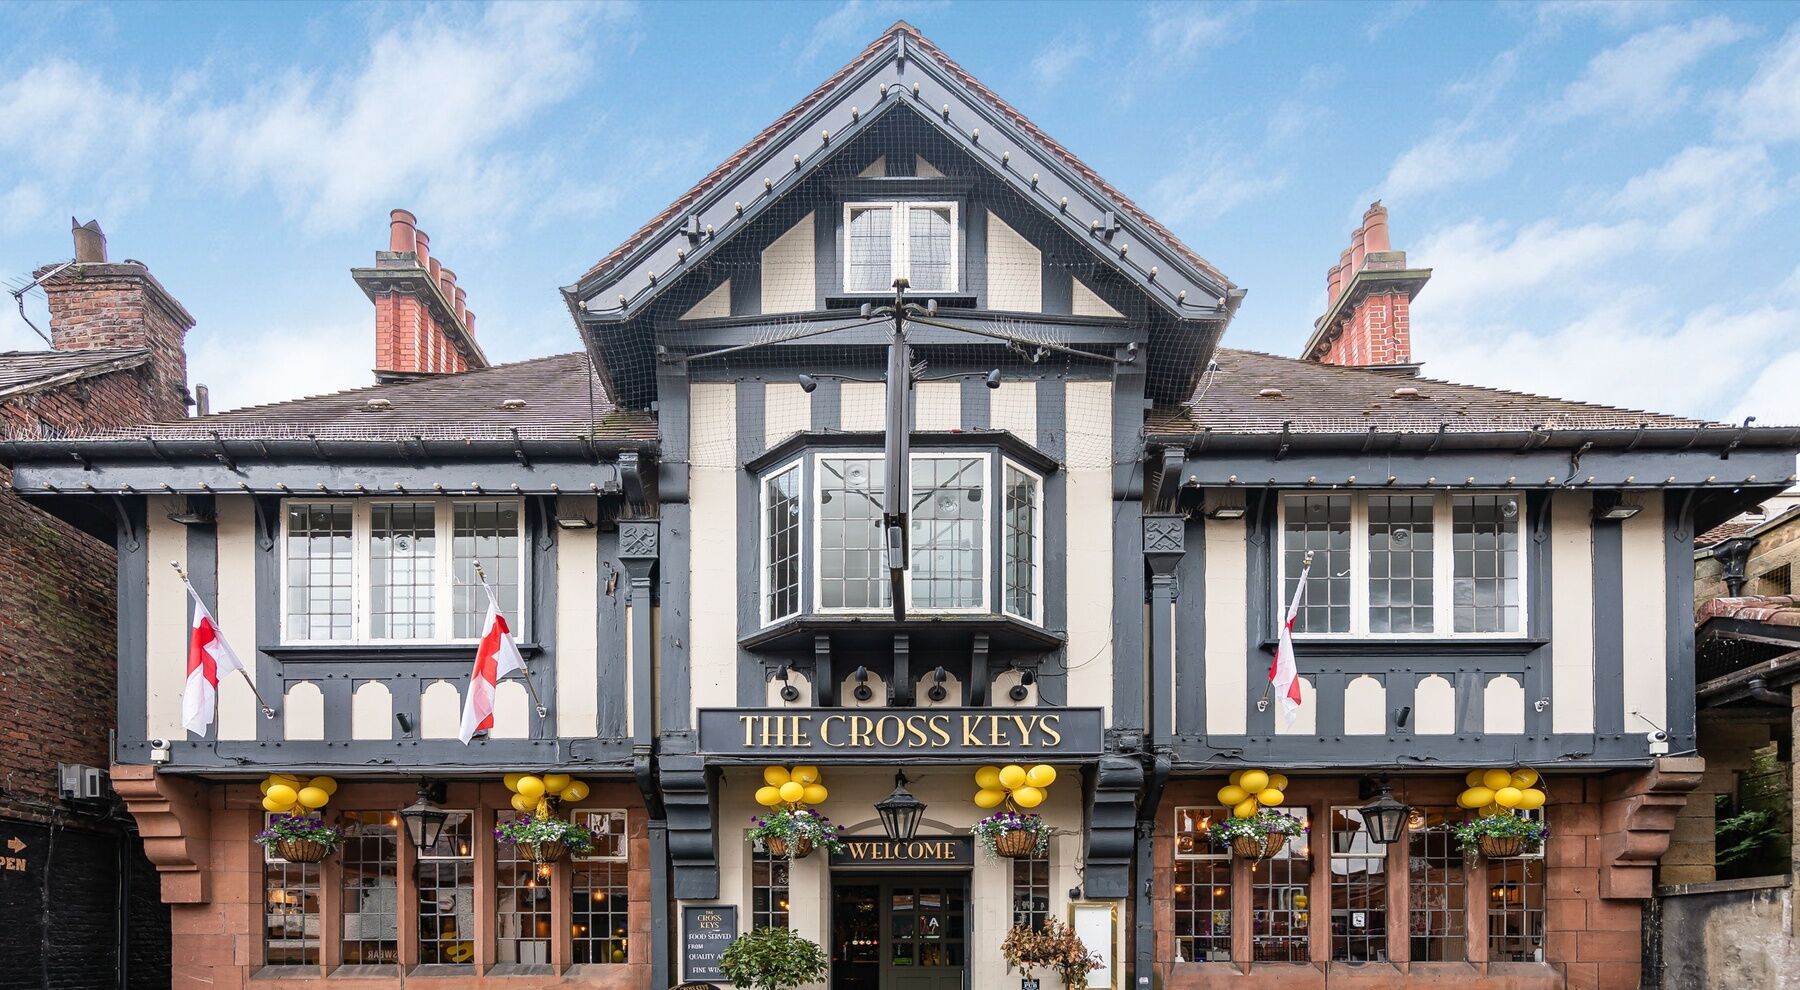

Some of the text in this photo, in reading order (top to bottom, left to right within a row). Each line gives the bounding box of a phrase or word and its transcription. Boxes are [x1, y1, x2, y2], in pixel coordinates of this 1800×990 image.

[739, 714, 1061, 748] THE CROSS KEYS
[847, 841, 956, 860] WELCOME
[0, 856, 27, 872] PEN
[700, 921, 720, 929] KEYS
[688, 953, 715, 961] QUALITY
[692, 966, 707, 974] FINE
